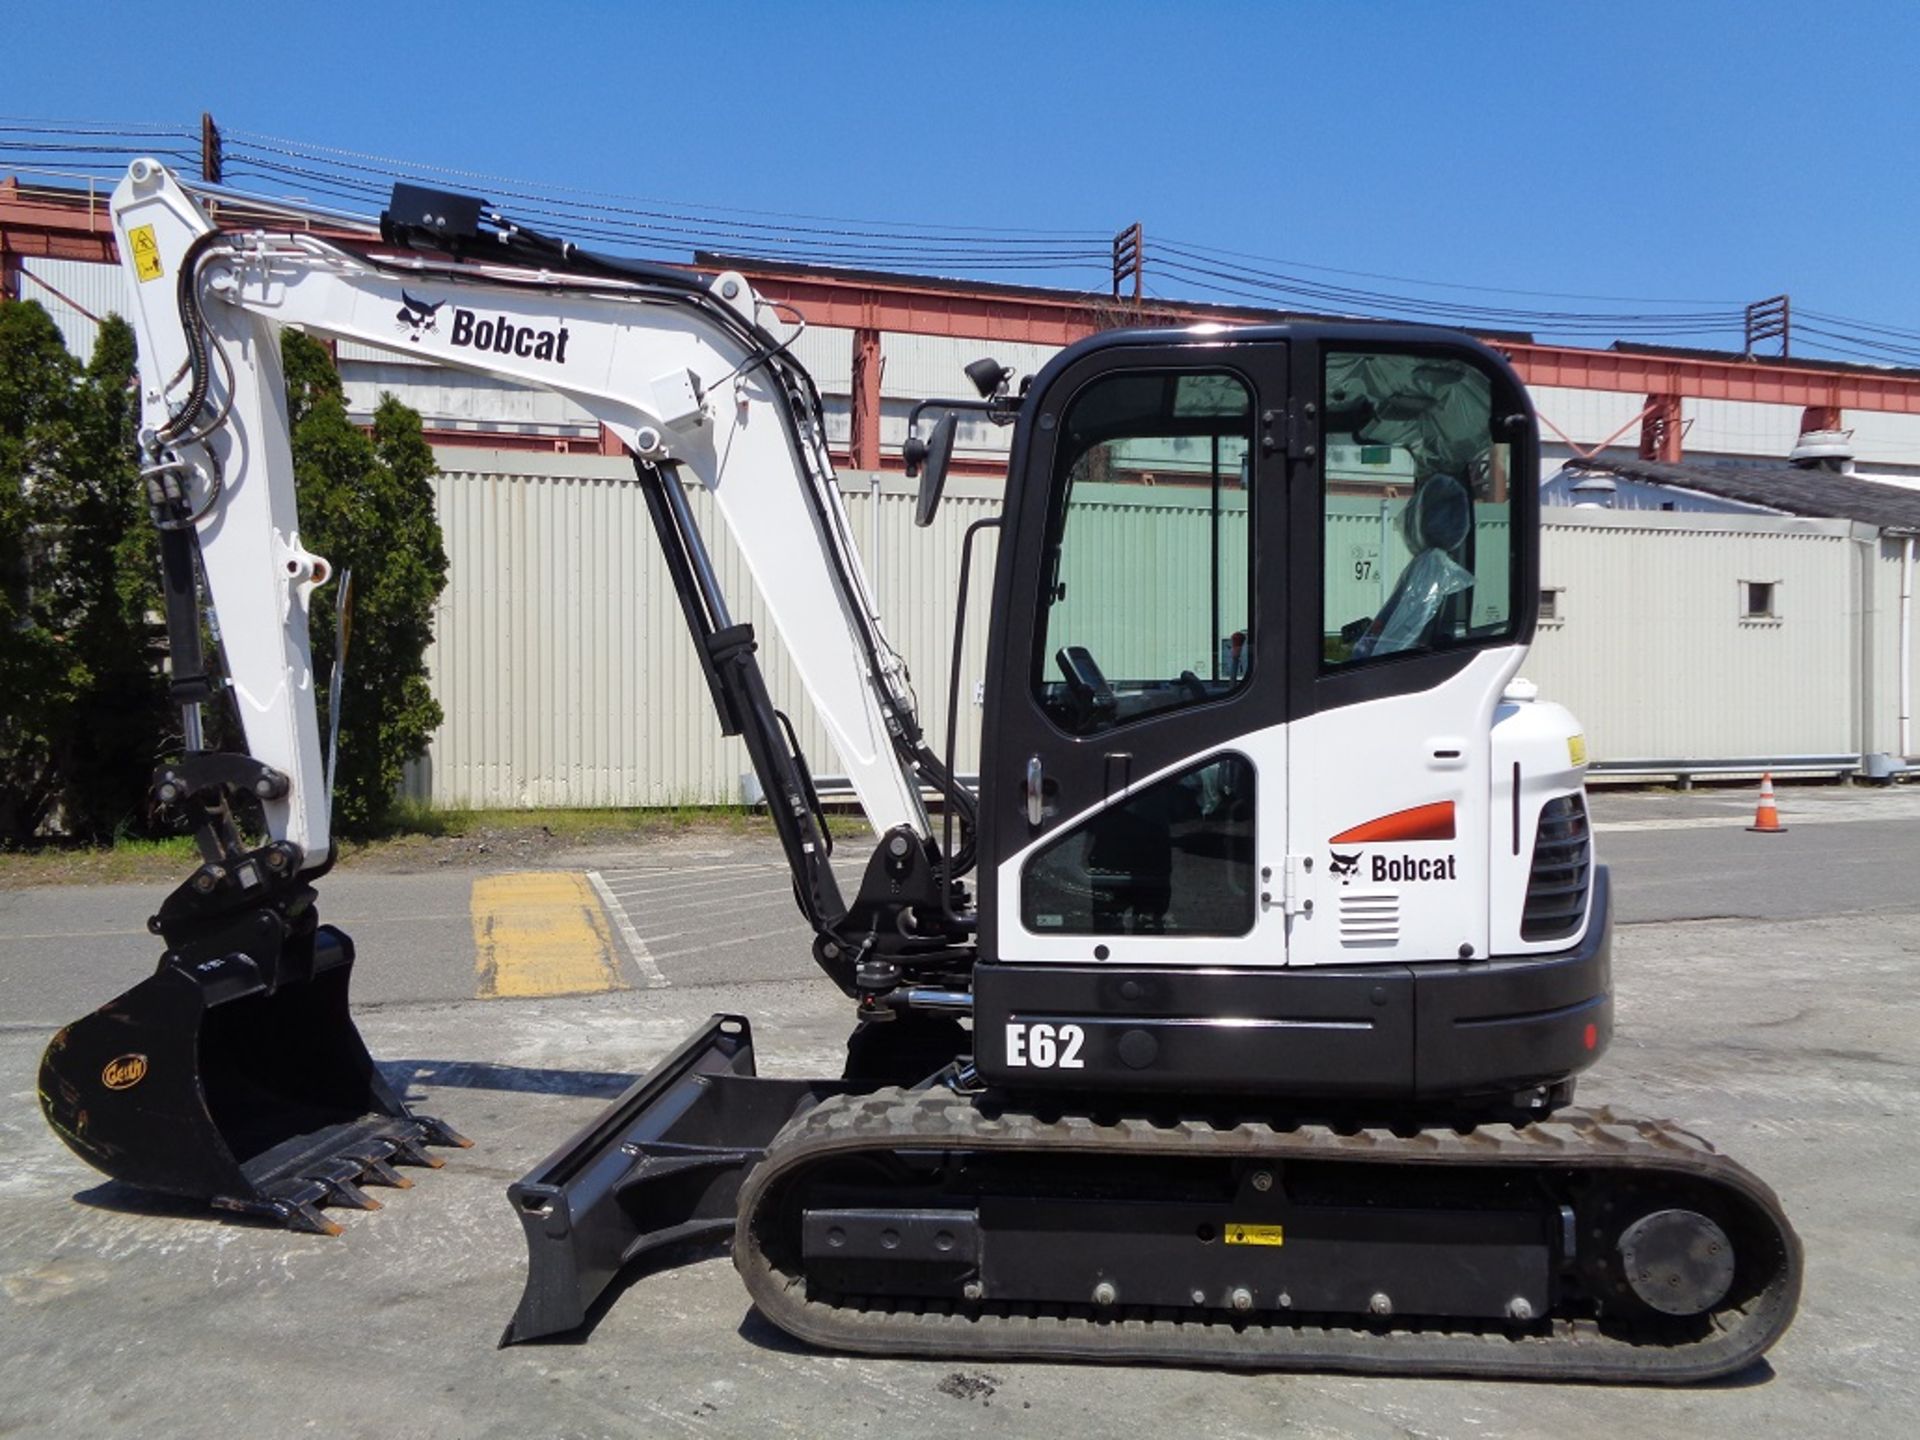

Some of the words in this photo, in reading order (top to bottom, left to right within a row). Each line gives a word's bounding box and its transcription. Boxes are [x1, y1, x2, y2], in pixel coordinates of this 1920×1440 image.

[451, 309, 569, 364] Bobcat
[1355, 561, 1371, 580] 97
[1371, 854, 1456, 882] Bobcat
[1006, 1023, 1085, 1068] E62
